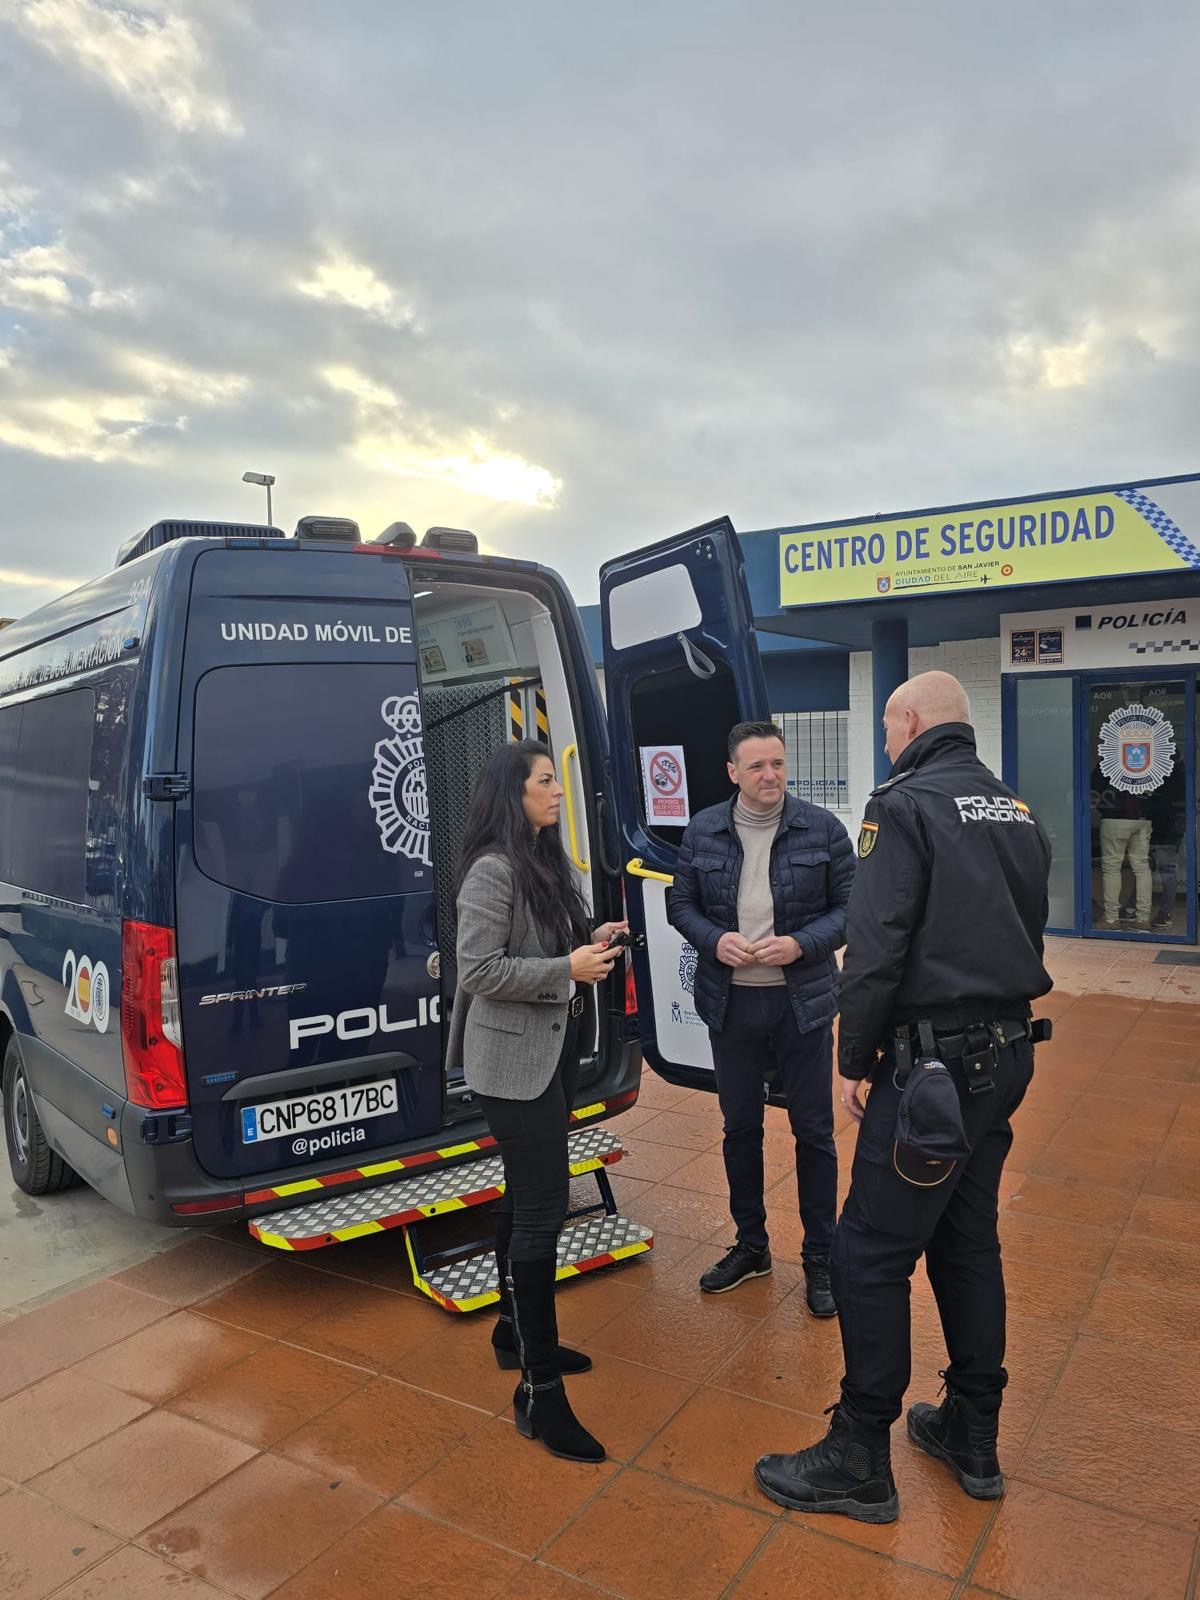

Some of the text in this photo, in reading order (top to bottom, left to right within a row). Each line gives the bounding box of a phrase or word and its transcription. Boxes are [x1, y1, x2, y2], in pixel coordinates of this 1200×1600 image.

[784, 504, 1115, 574] CENTRO DE SEGURIDAD
[895, 566, 946, 577] AYUNTAMIENTO
[974, 560, 1000, 569] JAVIER
[895, 575, 931, 586] CIUDAD
[933, 573, 949, 582] DEL
[1097, 608, 1186, 630] POLICÍA
[220, 623, 308, 641] UNIDAD
[314, 620, 380, 643] MÓVIL
[385, 626, 413, 644] DE
[959, 808, 1035, 825] NACIONAL
[62, 948, 109, 1034] 200
[199, 983, 308, 1006] SPRINTER
[289, 995, 440, 1050] POLI
[247, 1084, 394, 1137] E CNP6817BC
[292, 1127, 366, 1156] @policia
